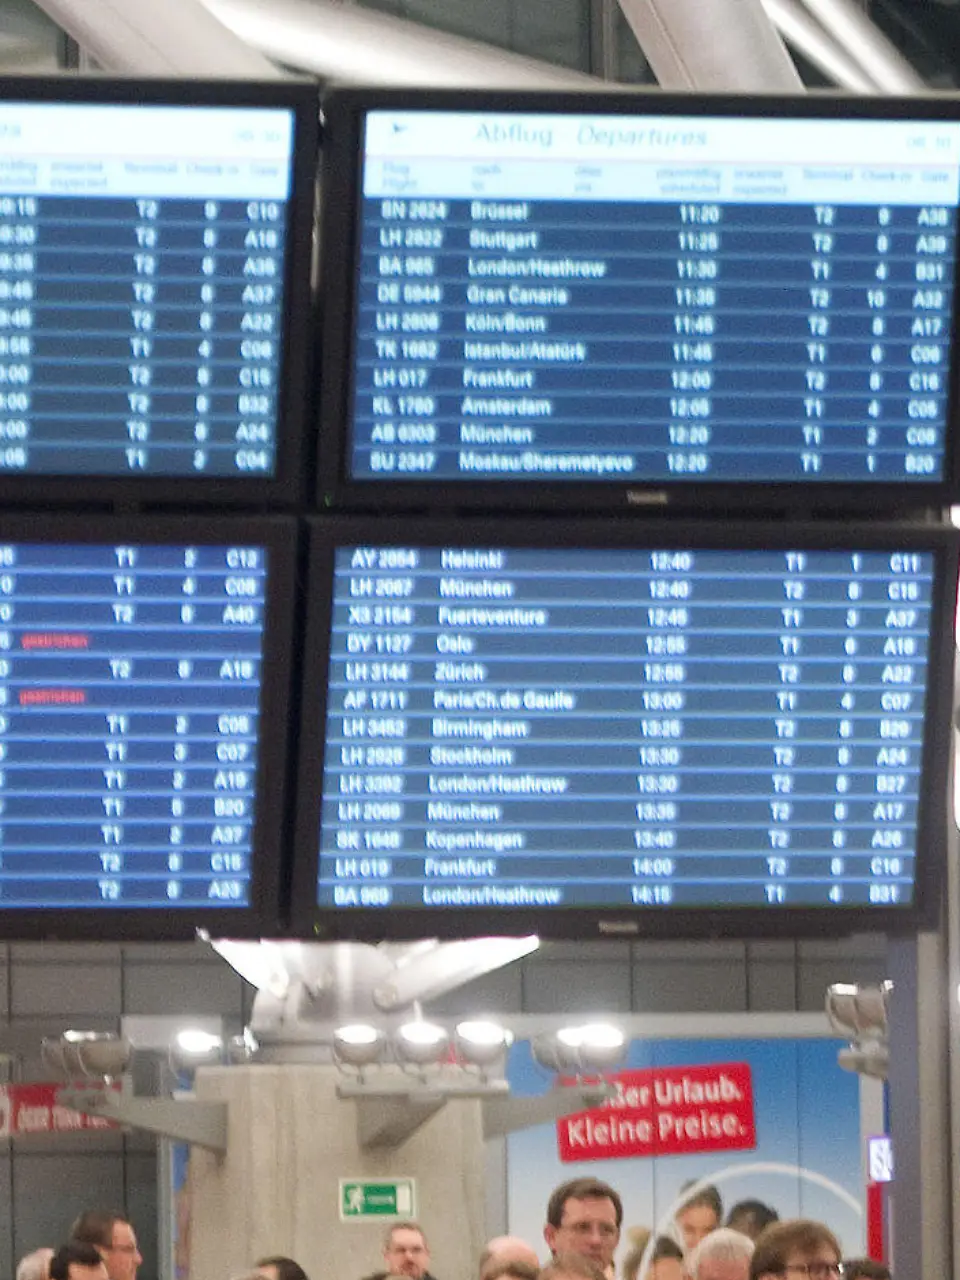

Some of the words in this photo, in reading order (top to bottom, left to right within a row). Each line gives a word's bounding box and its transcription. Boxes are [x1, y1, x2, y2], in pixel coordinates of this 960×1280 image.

[812, 259, 829, 279] T1
[131, 337, 150, 357] T1
[808, 342, 825, 361] T1
[400, 368, 427, 386] 017
[464, 369, 532, 387] Frankfurt
[462, 398, 551, 414] Amsterdam
[805, 397, 822, 416] T1
[461, 424, 532, 442] München
[803, 424, 820, 443] T1
[126, 447, 145, 467] T1
[802, 452, 820, 470] T1
[867, 454, 874, 471] 1
[116, 548, 135, 566] T1
[442, 551, 504, 569] Helsinki
[786, 553, 805, 571] T1
[852, 554, 861, 572] 1
[114, 574, 133, 594] T1
[440, 579, 512, 596] München
[782, 607, 801, 626] T1
[437, 634, 473, 652] Oslo
[781, 636, 799, 653] T1
[435, 662, 485, 680] Zürich
[778, 691, 796, 709] T1
[842, 693, 853, 709] 4
[107, 710, 127, 733] T1
[433, 719, 527, 736] Birmingham
[106, 738, 126, 760] T1
[431, 747, 513, 764] Stockholm
[104, 765, 124, 788] T1
[430, 776, 567, 792] London/Heathrow
[103, 793, 123, 816] T1
[428, 803, 500, 820] München
[102, 821, 121, 843] T1
[427, 832, 523, 851] Kopenhagen
[425, 858, 495, 875] Frankfurt
[423, 886, 560, 903] London/Heathrow
[766, 882, 785, 902] T1
[829, 885, 842, 901] 4
[654, 1074, 742, 1105] Urlaub.
[568, 1116, 650, 1147] Kleine
[658, 1110, 746, 1141] Preise.
